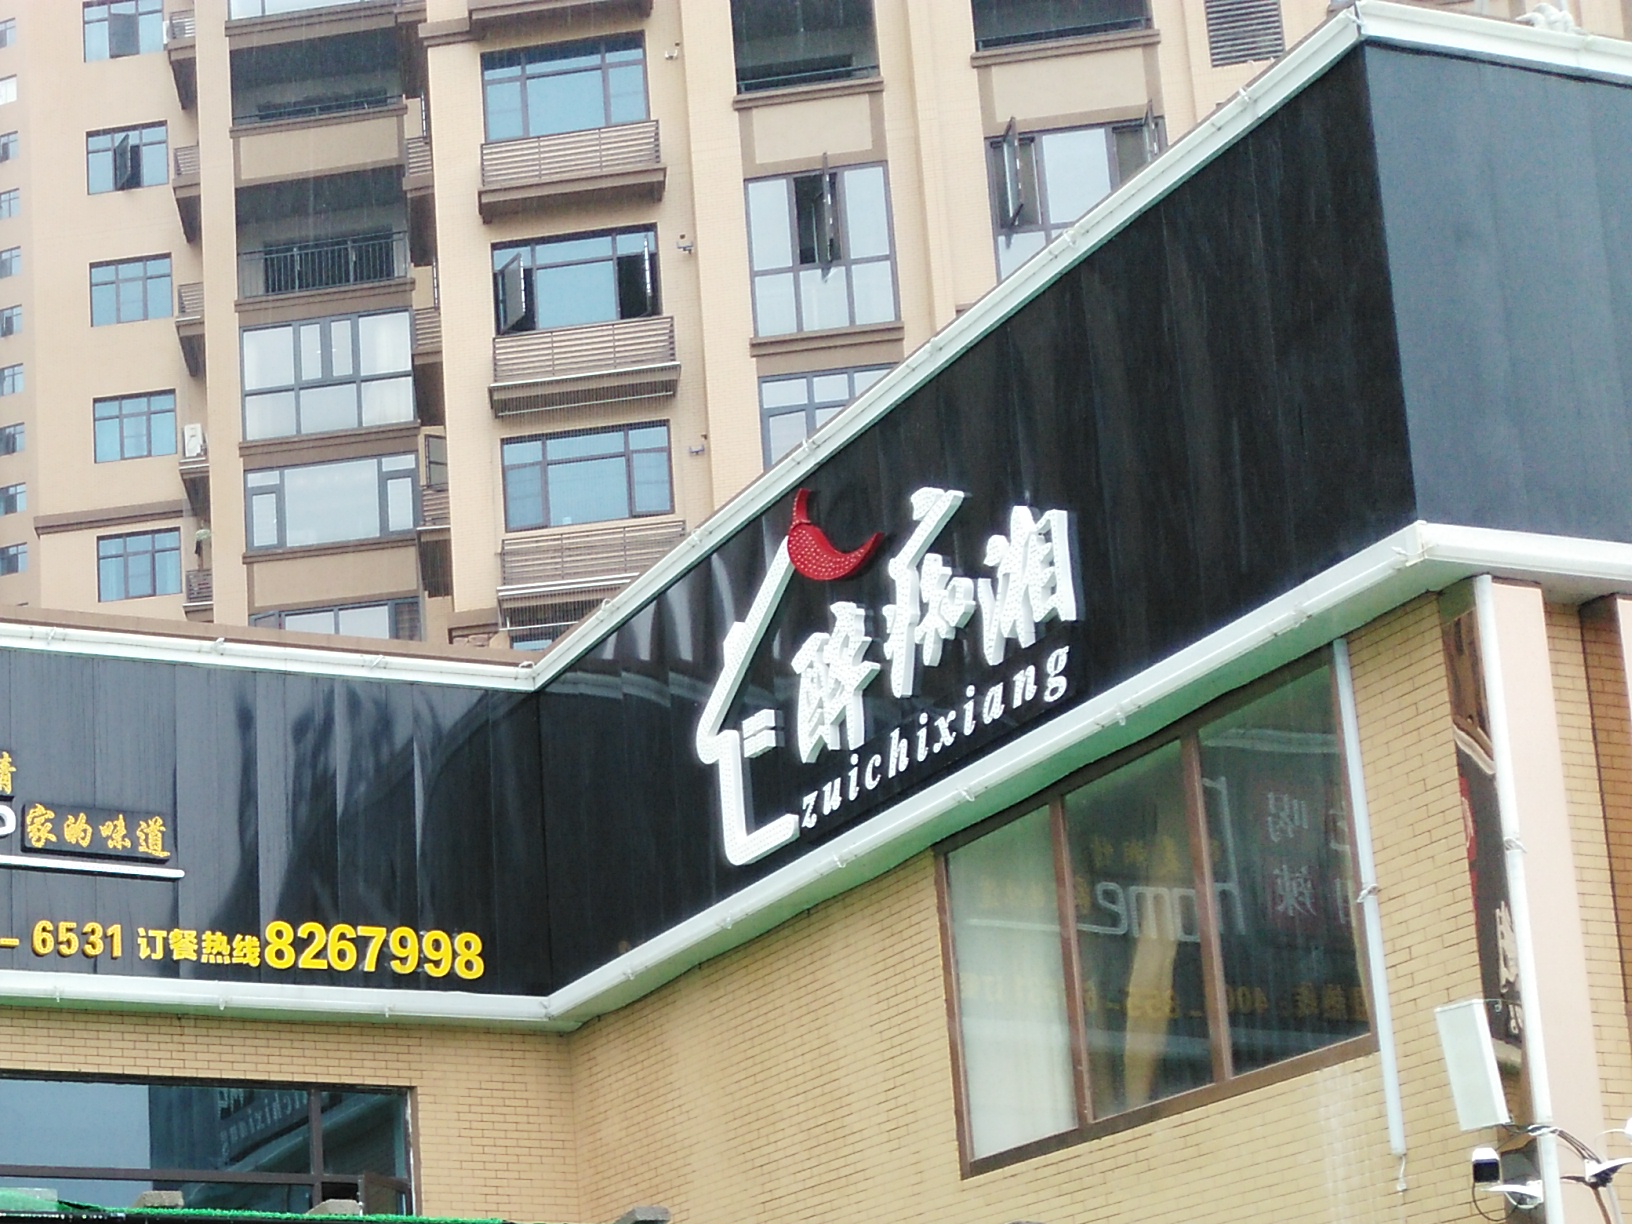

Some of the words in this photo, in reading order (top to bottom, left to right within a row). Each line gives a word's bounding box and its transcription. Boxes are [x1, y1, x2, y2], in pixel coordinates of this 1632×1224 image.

[790, 486, 1078, 764] 醉痴湘
[801, 645, 1070, 829] zuichixiang
[26, 803, 171, 858] 家的味道
